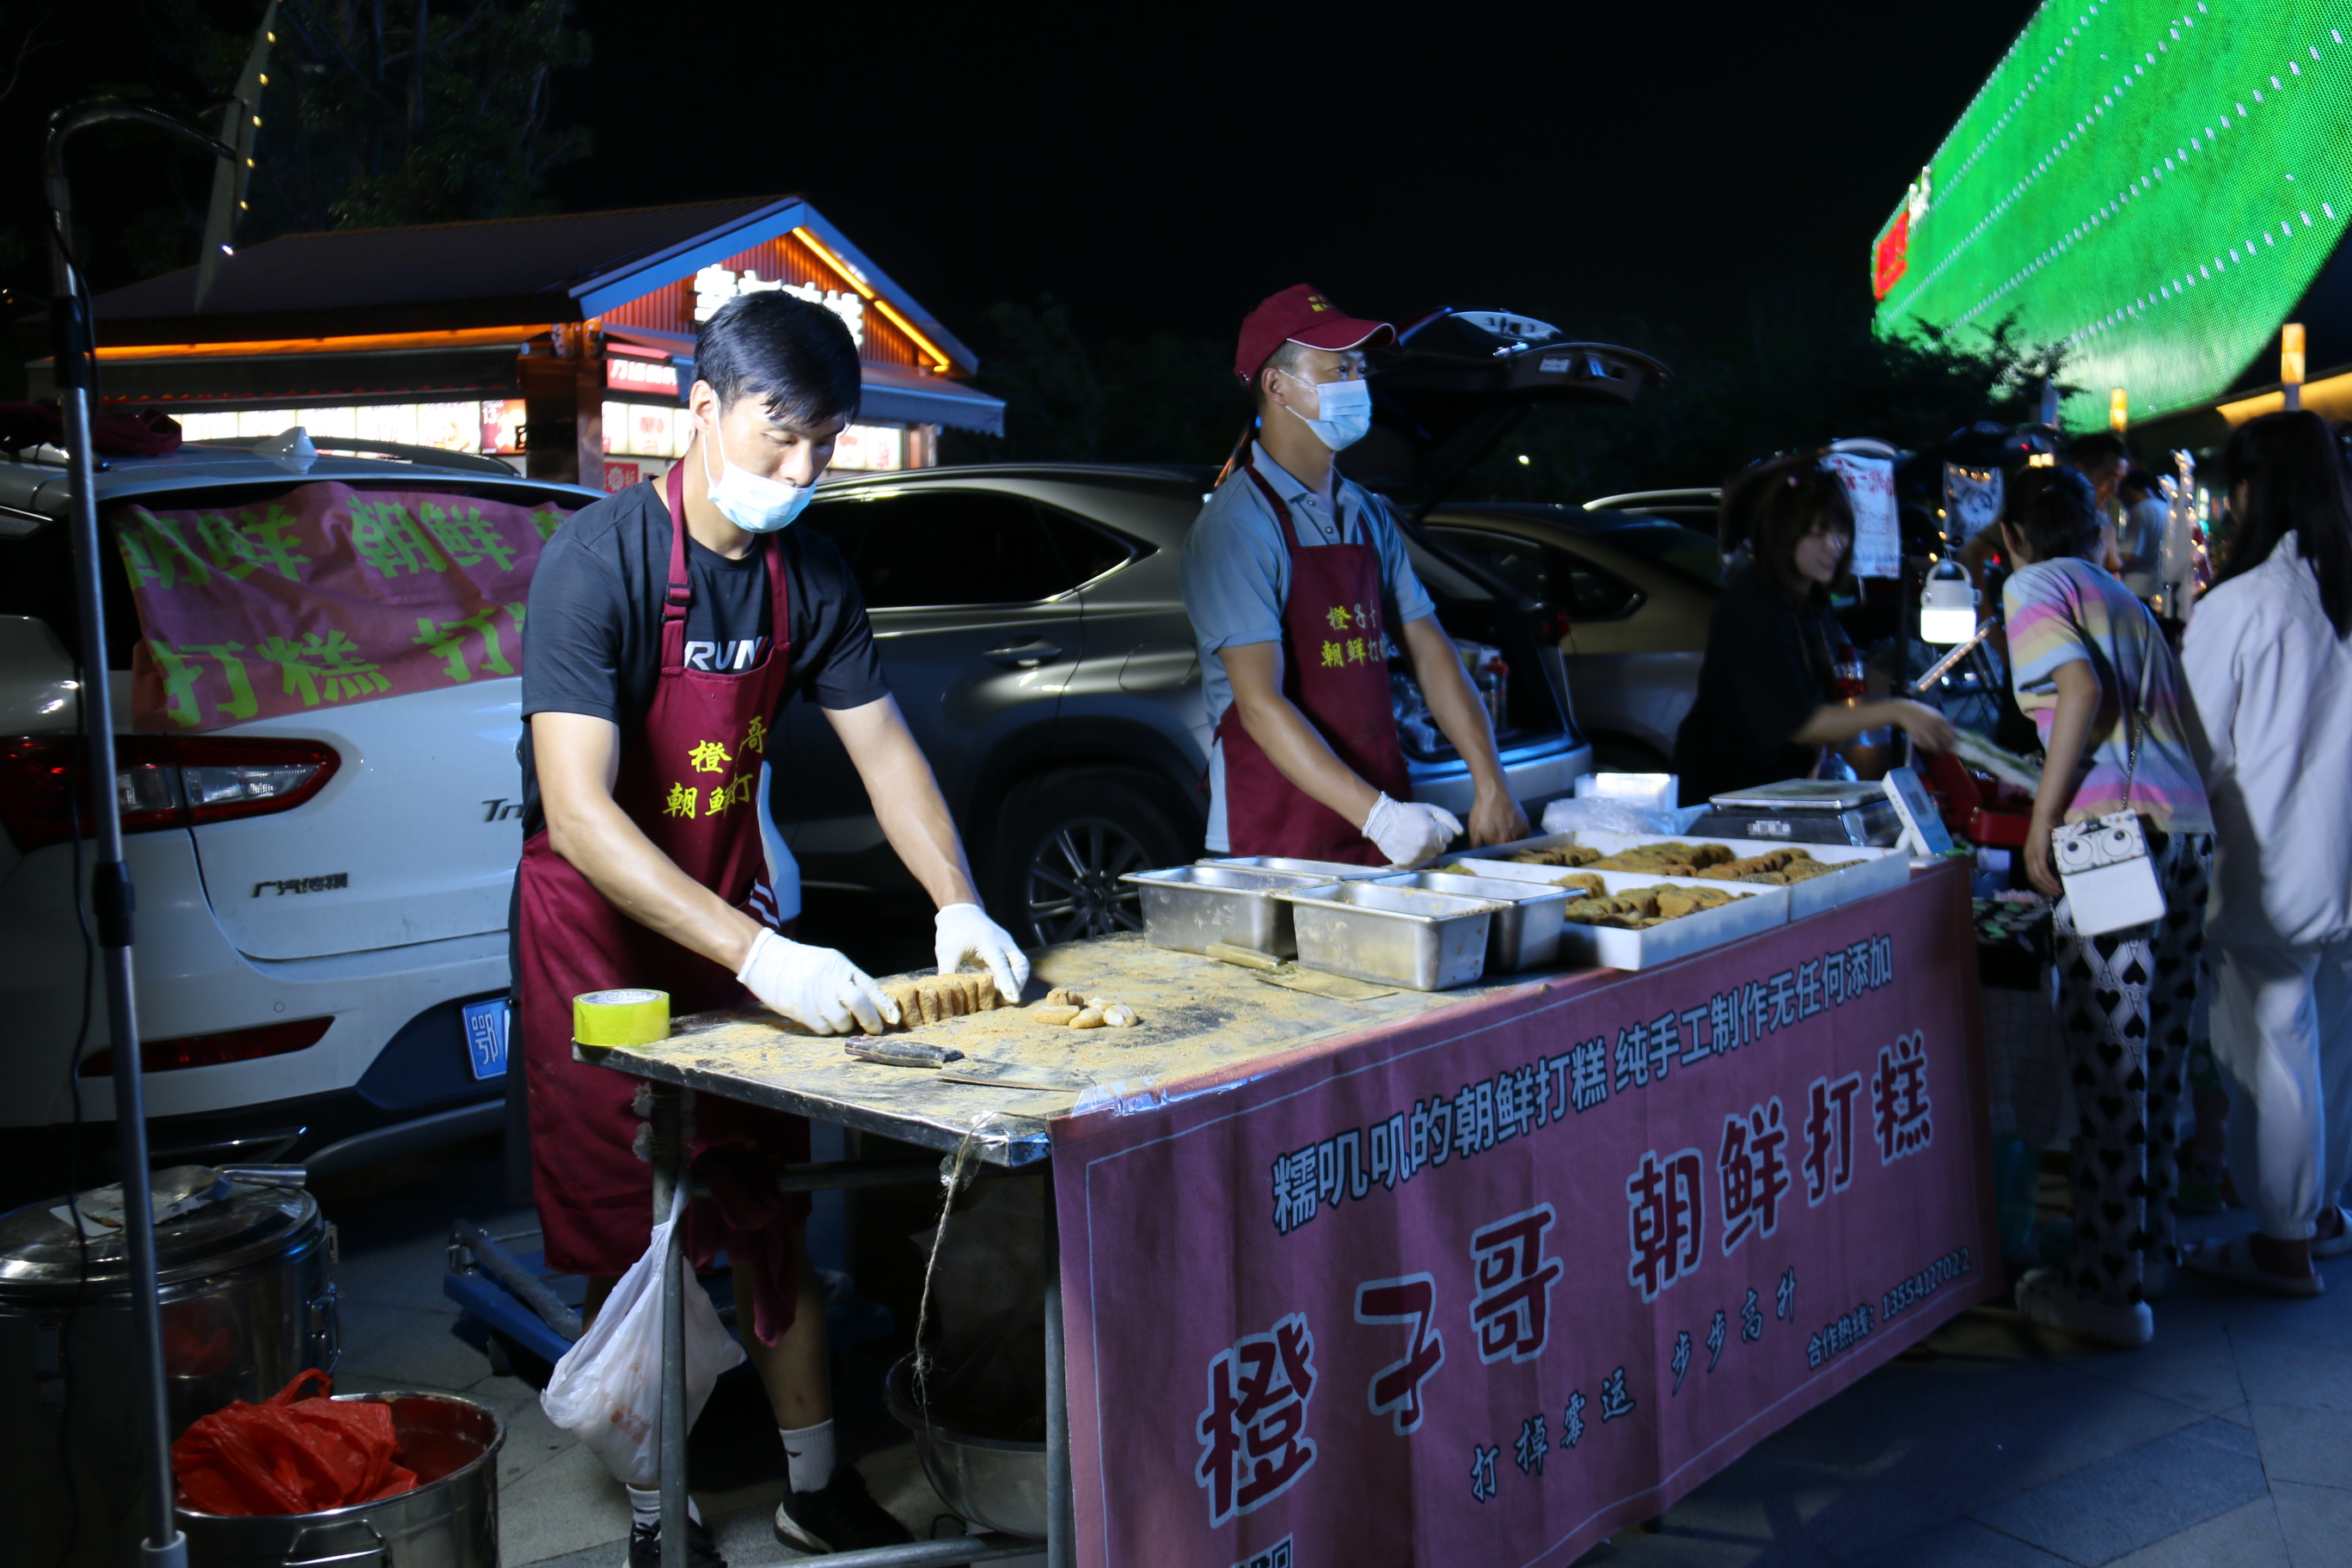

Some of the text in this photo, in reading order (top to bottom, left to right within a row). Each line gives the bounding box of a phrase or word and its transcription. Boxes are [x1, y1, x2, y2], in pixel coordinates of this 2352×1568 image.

[1196, 1028, 1933, 1528] 橙子哥 朝鲜打糕
[1271, 934, 1893, 1236] 糯叽叽的朝鲜打糕 纯手工制作无任何添加
